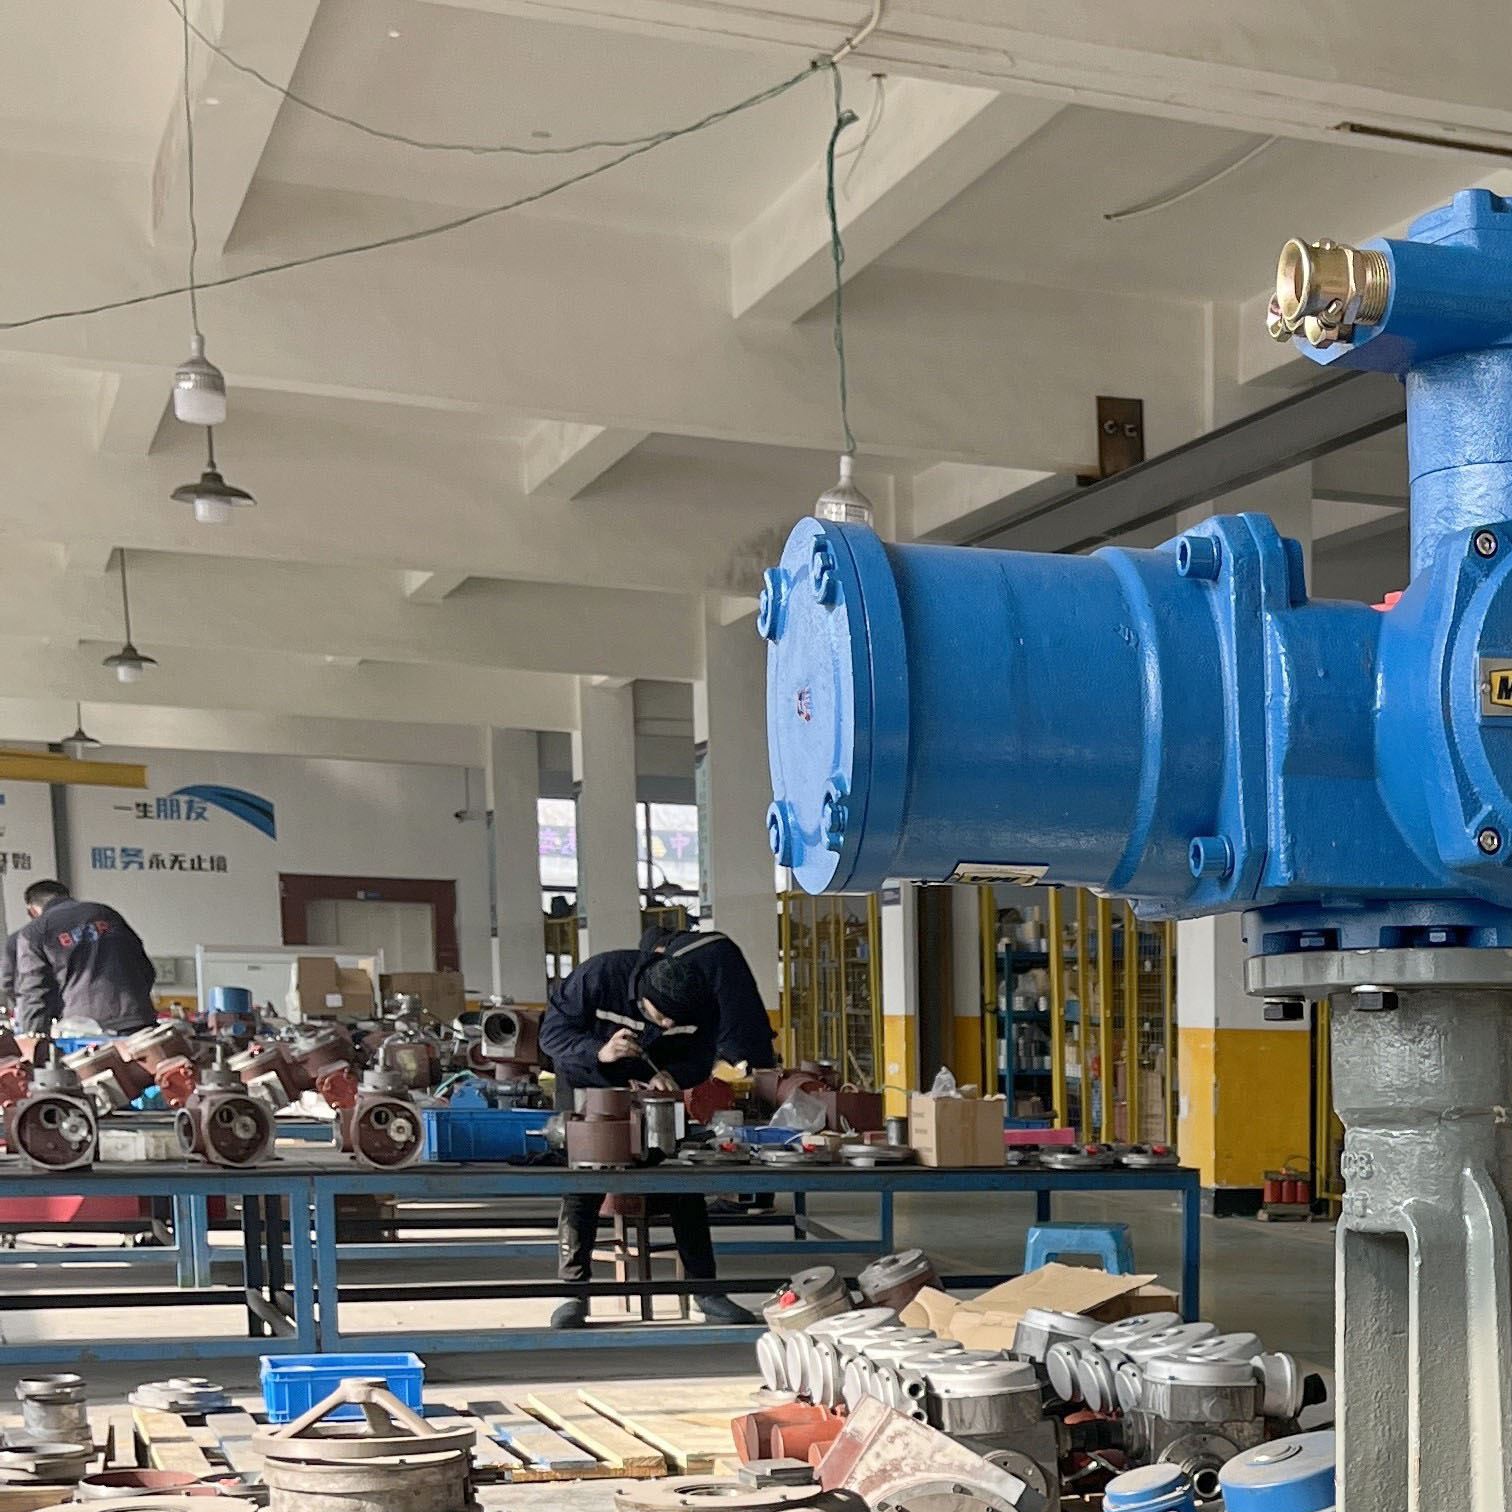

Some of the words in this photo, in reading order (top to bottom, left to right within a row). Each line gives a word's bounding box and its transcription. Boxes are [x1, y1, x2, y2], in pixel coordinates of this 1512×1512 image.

[112, 797, 209, 821] 一生朋友
[91, 846, 228, 873] 服务永无止境
